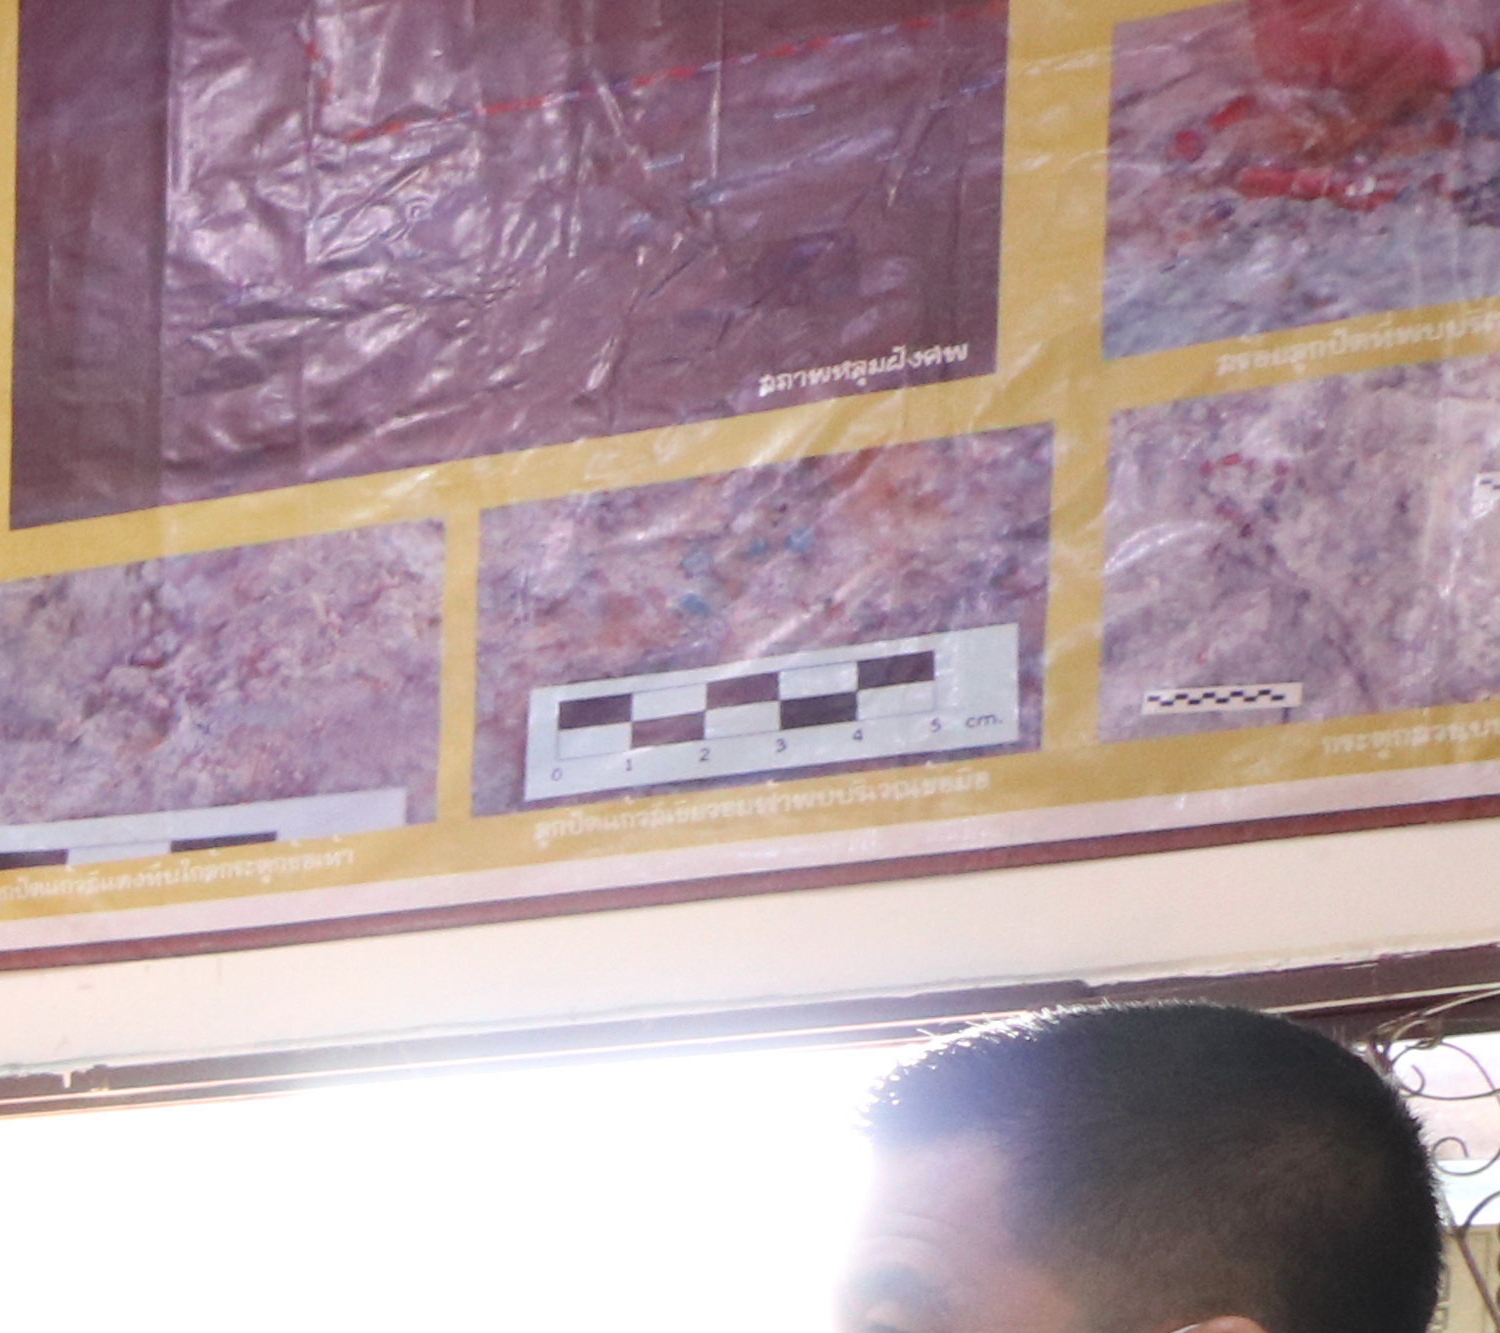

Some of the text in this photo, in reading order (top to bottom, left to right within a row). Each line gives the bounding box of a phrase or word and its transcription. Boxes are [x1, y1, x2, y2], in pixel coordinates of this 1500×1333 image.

[759, 343, 970, 398] สภาพหลุมฝังศพ
[930, 713, 1003, 732] 5 cm.
[852, 727, 864, 742] 4
[775, 738, 787, 753] 3
[698, 747, 711, 763] 2
